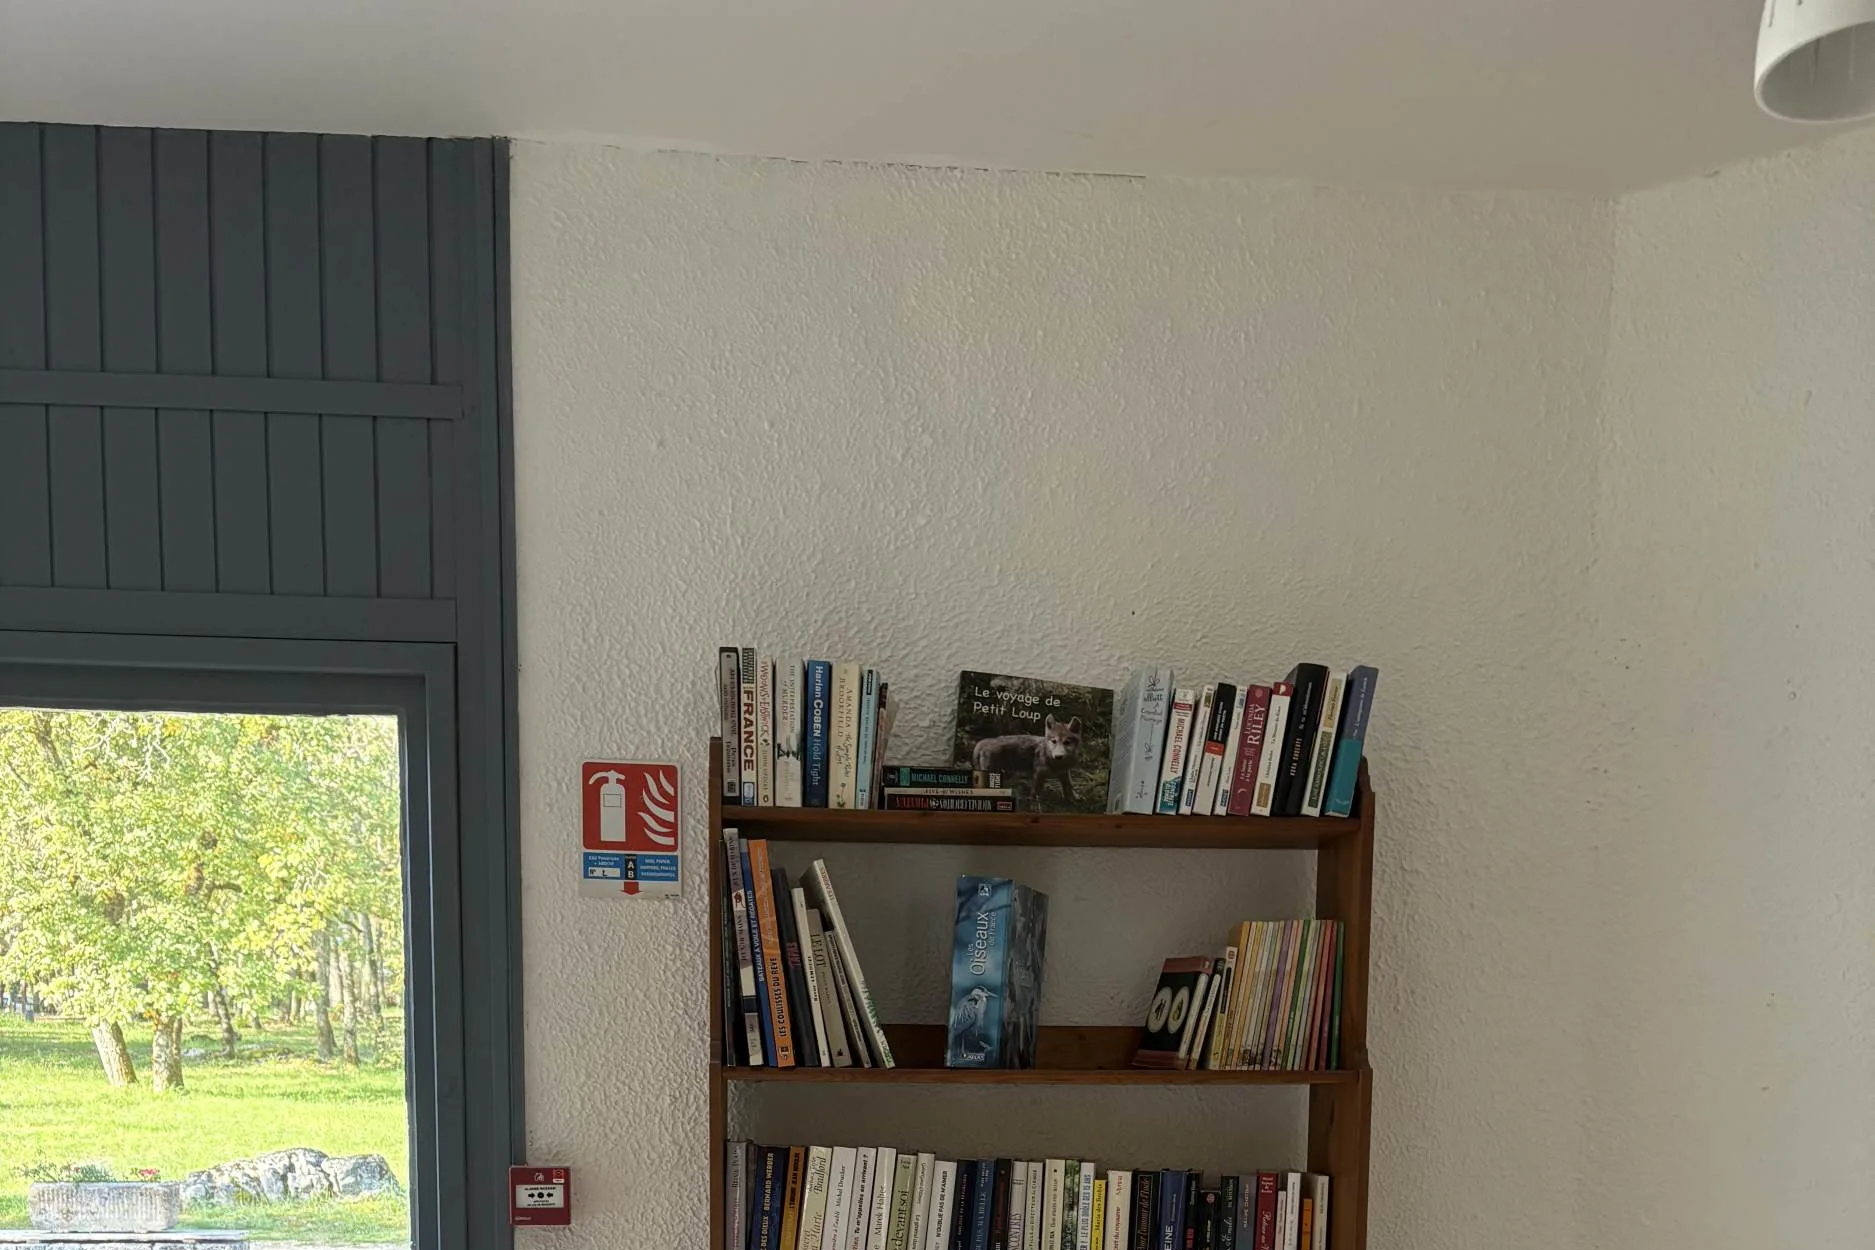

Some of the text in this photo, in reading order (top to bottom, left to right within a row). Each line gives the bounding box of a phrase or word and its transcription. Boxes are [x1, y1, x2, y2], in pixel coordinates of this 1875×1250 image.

[782, 688, 790, 721] MURDER
[813, 665, 824, 737] Harlan COBEN
[845, 687, 854, 728] AMANDA
[975, 687, 1061, 708] Le voyage de
[973, 702, 1041, 724] Petit Loup
[1247, 704, 1266, 746] RILEY
[743, 689, 754, 772] FRANCE
[1169, 717, 1186, 774] MICHAEL CONNELLY
[810, 738, 821, 786] Hold Tight
[911, 773, 969, 785] MICHAEL CONNELLY
[627, 860, 635, 869] A
[751, 919, 758, 928] ET
[988, 911, 997, 935] France
[752, 928, 761, 947] VOILE
[968, 911, 989, 976] Oiseaux
[966, 943, 974, 957] Les
[755, 953, 766, 982] BATEAUX
[771, 976, 779, 987] DU
[774, 988, 785, 1024] COULISSES
[778, 1026, 787, 1037] LES
[762, 1152, 775, 1211] BERNARD WERBER
[812, 1155, 828, 1195] Bradford
[1083, 1174, 1091, 1185] ANS
[855, 1193, 865, 1226] m'appelles
[860, 1159, 869, 1184] arrivant
[895, 1190, 909, 1206] soi
[936, 1171, 948, 1238] N'OUBLIE PAS DE M'AIMER
[760, 1215, 769, 1235] DIEUX
[808, 1211, 823, 1242] Harte
[872, 1212, 883, 1236] Marek
[891, 1206, 906, 1247] devant
[1080, 1218, 1089, 1231] PLUS
[1094, 1213, 1102, 1231] Maria
[759, 1235, 768, 1247] DES
